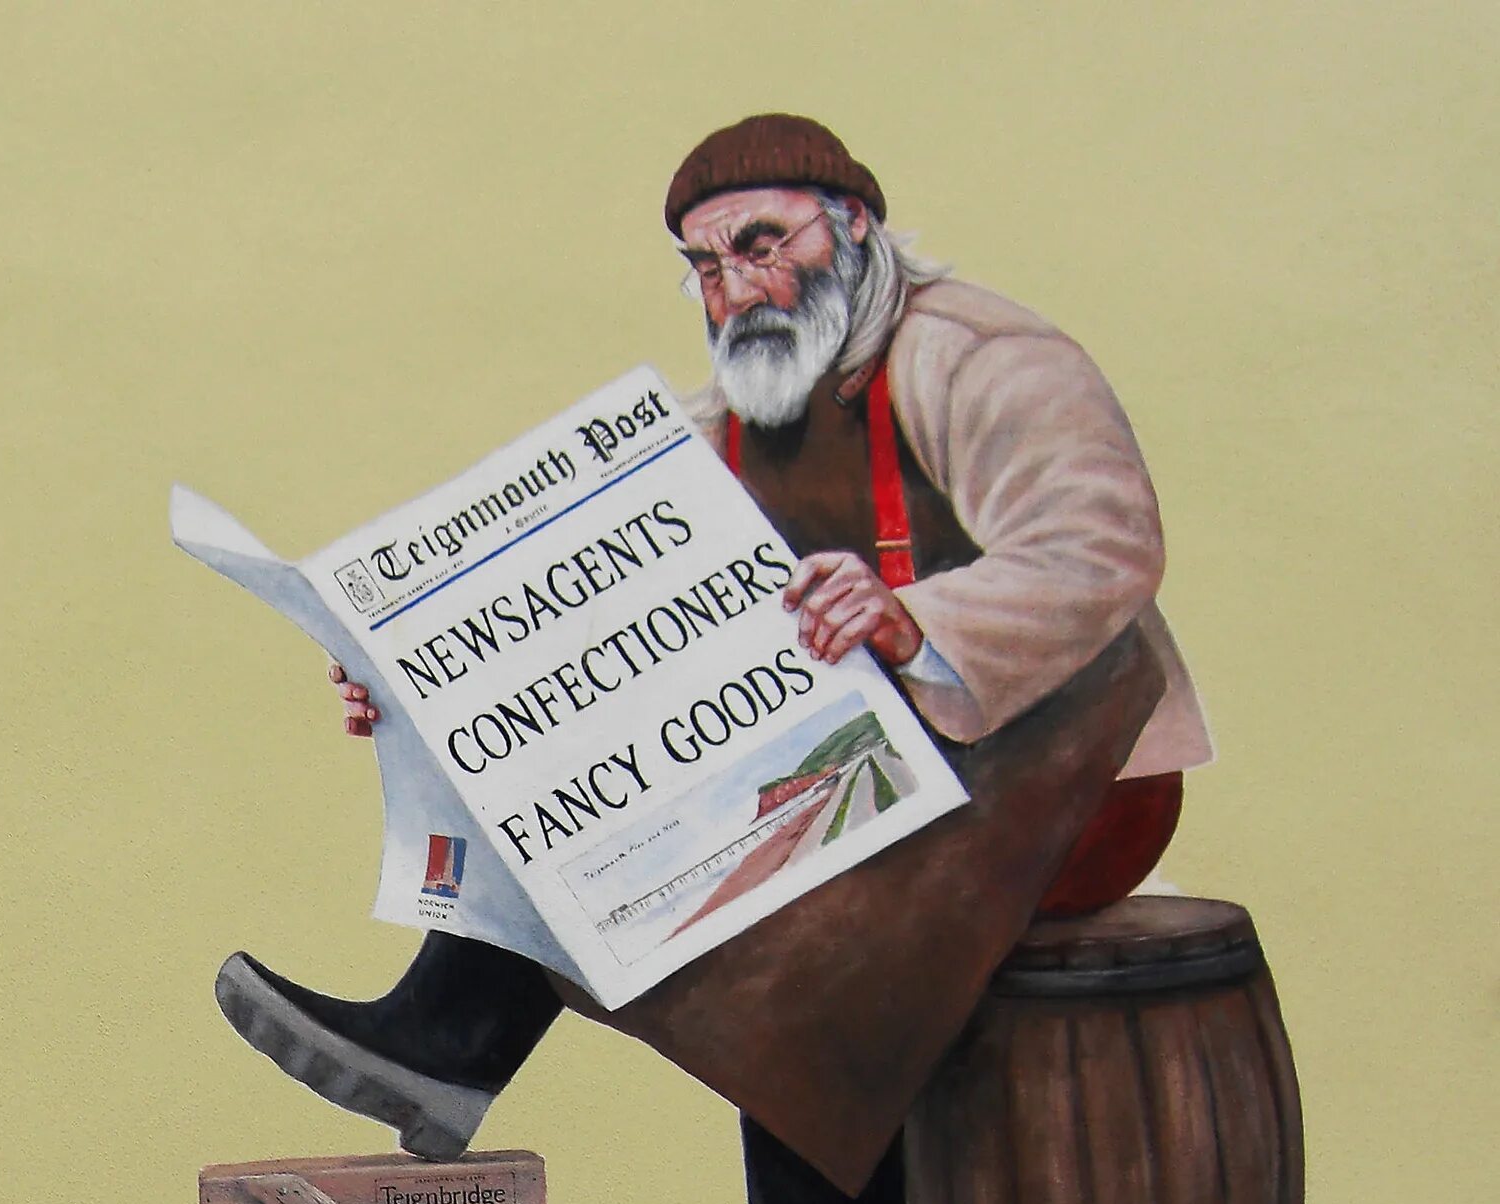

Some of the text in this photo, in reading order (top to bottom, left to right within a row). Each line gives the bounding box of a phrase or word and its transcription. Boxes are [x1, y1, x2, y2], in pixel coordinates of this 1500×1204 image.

[371, 390, 669, 581] Teignmouth Post
[397, 500, 692, 700] NEWSAGENTS
[448, 543, 794, 775] CONFECTIONERS
[499, 648, 815, 866] FANCY GOODS
